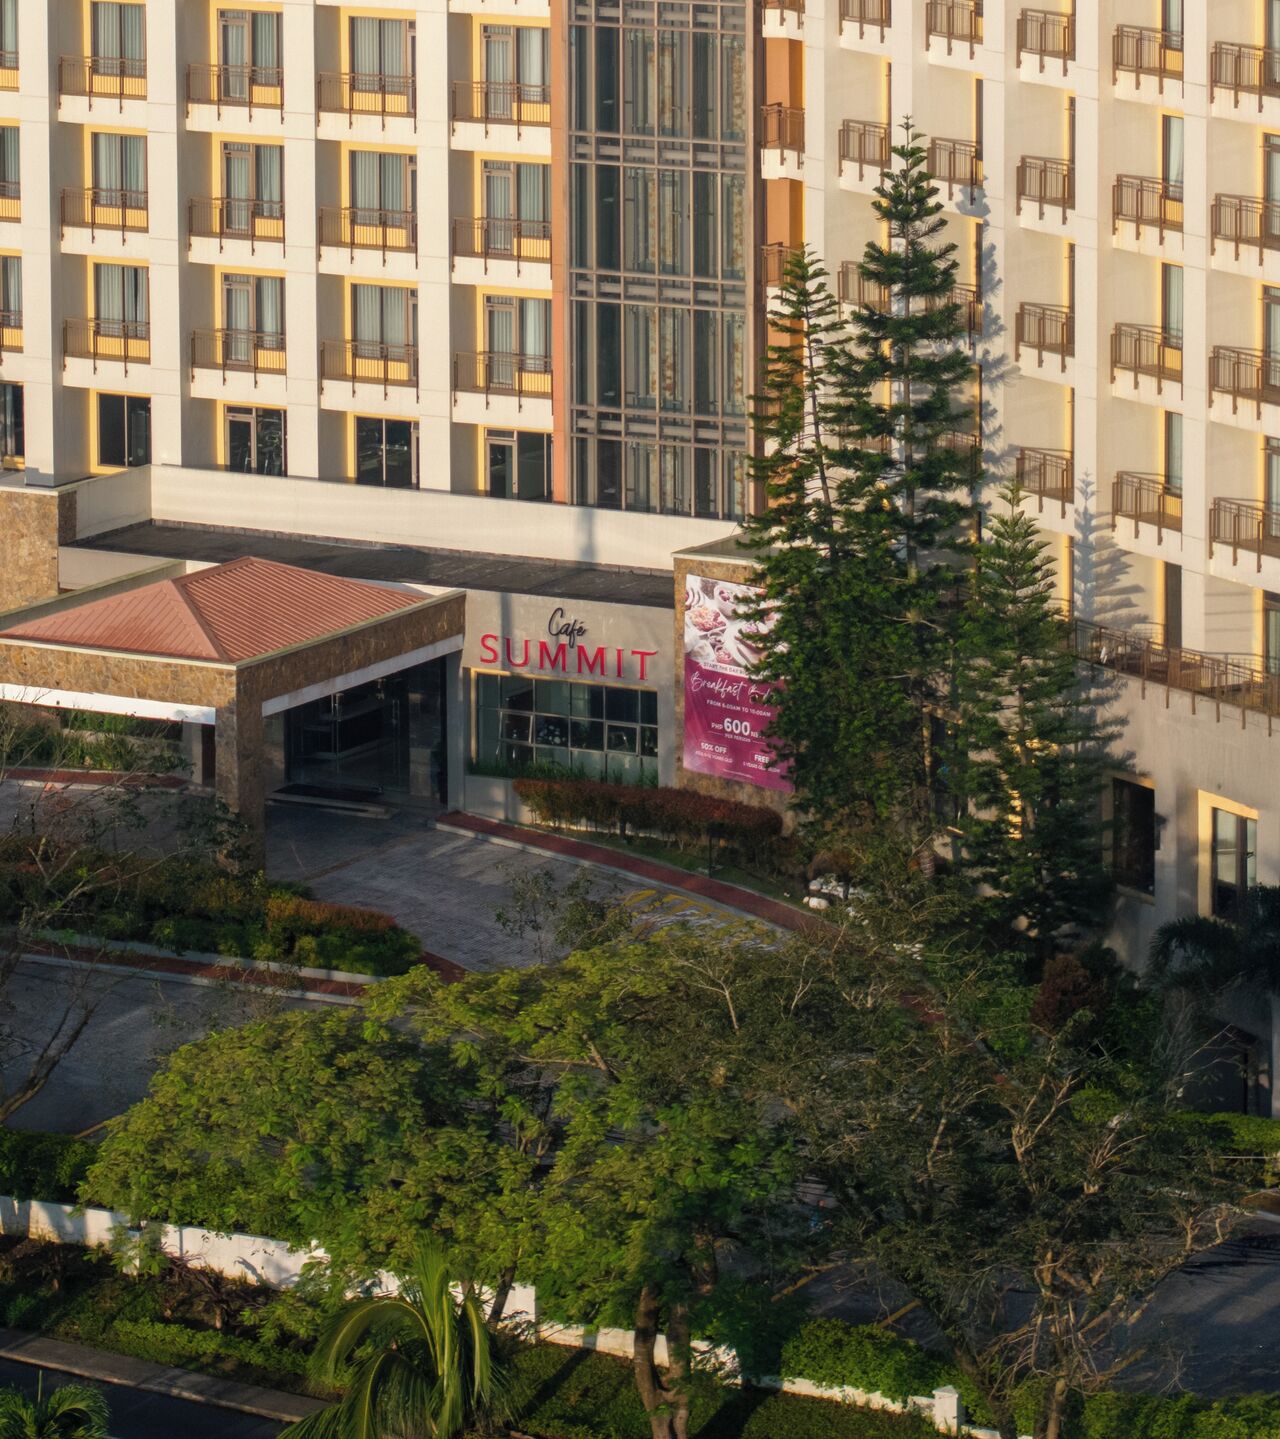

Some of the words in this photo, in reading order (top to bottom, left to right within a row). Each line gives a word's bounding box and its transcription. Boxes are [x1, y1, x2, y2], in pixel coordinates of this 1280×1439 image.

[548, 607, 588, 648] Café
[480, 634, 658, 680] SUMMIT
[690, 671, 747, 701] Breakfast
[706, 699, 721, 707] FROM
[711, 722, 723, 730] PHP
[724, 717, 750, 736] 600
[714, 745, 727, 754] OFF
[754, 754, 769, 764] FREE
